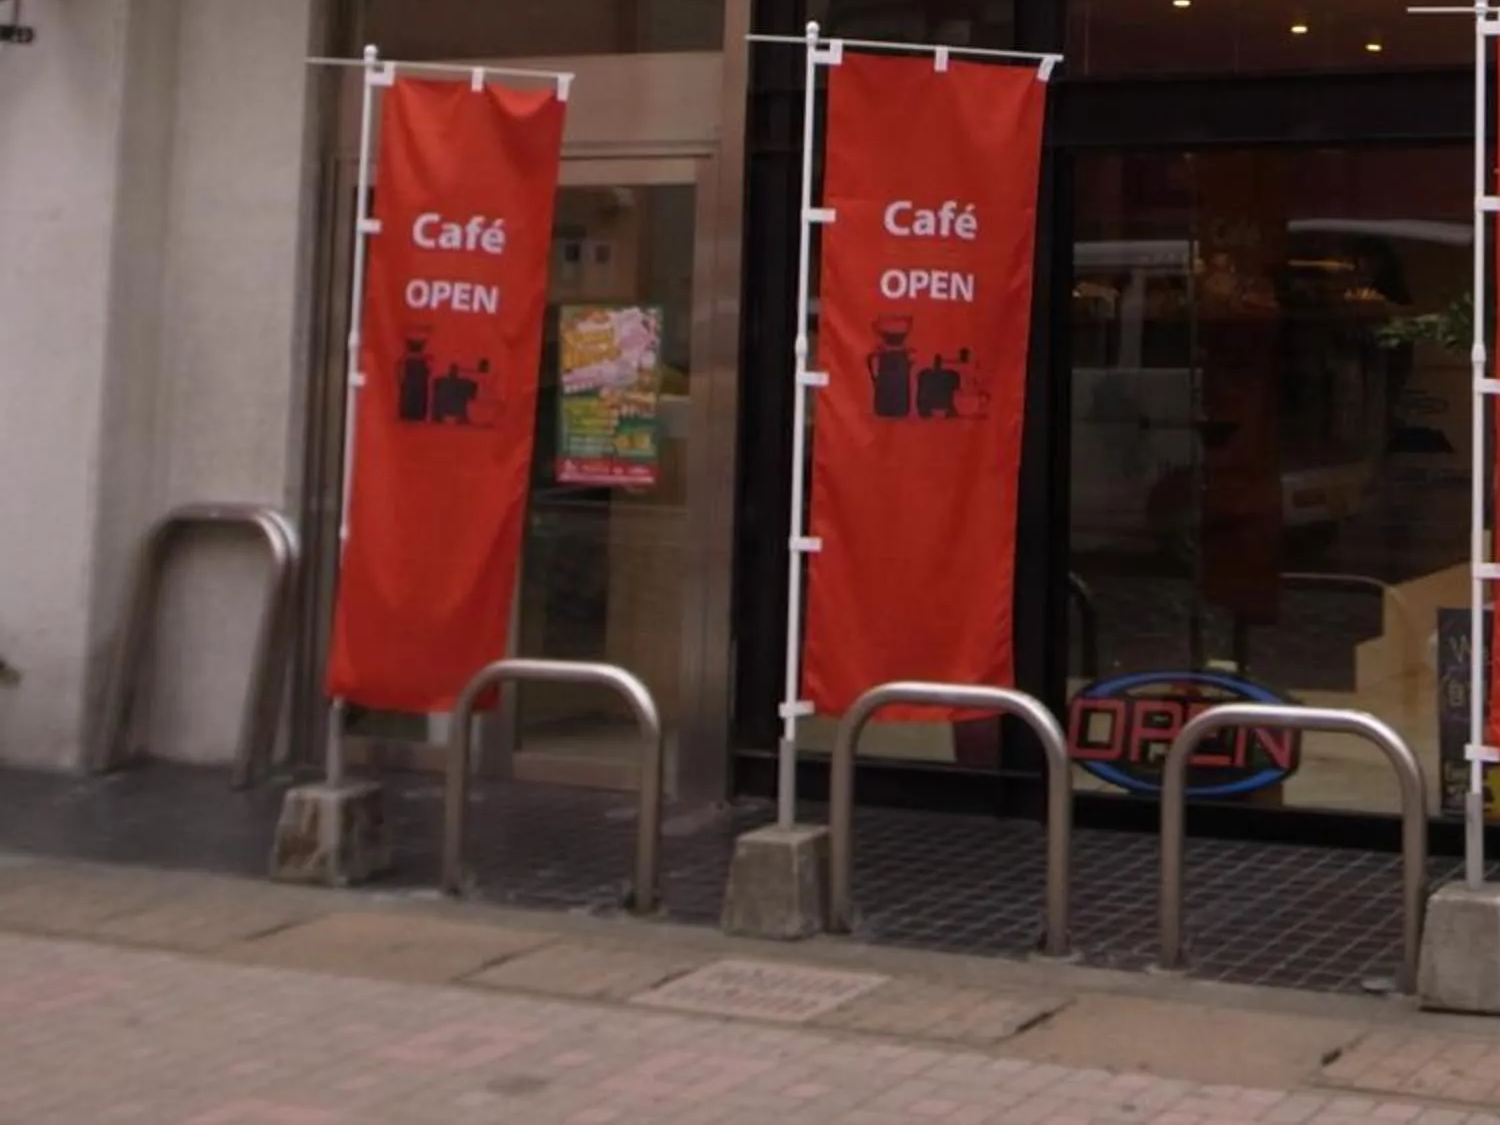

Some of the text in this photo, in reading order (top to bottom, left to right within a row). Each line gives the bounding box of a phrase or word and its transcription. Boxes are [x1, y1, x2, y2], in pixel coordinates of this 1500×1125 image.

[412, 212, 506, 254] Café
[883, 200, 978, 240] Café
[405, 278, 499, 314] OPEN
[880, 268, 975, 303] OPEN
